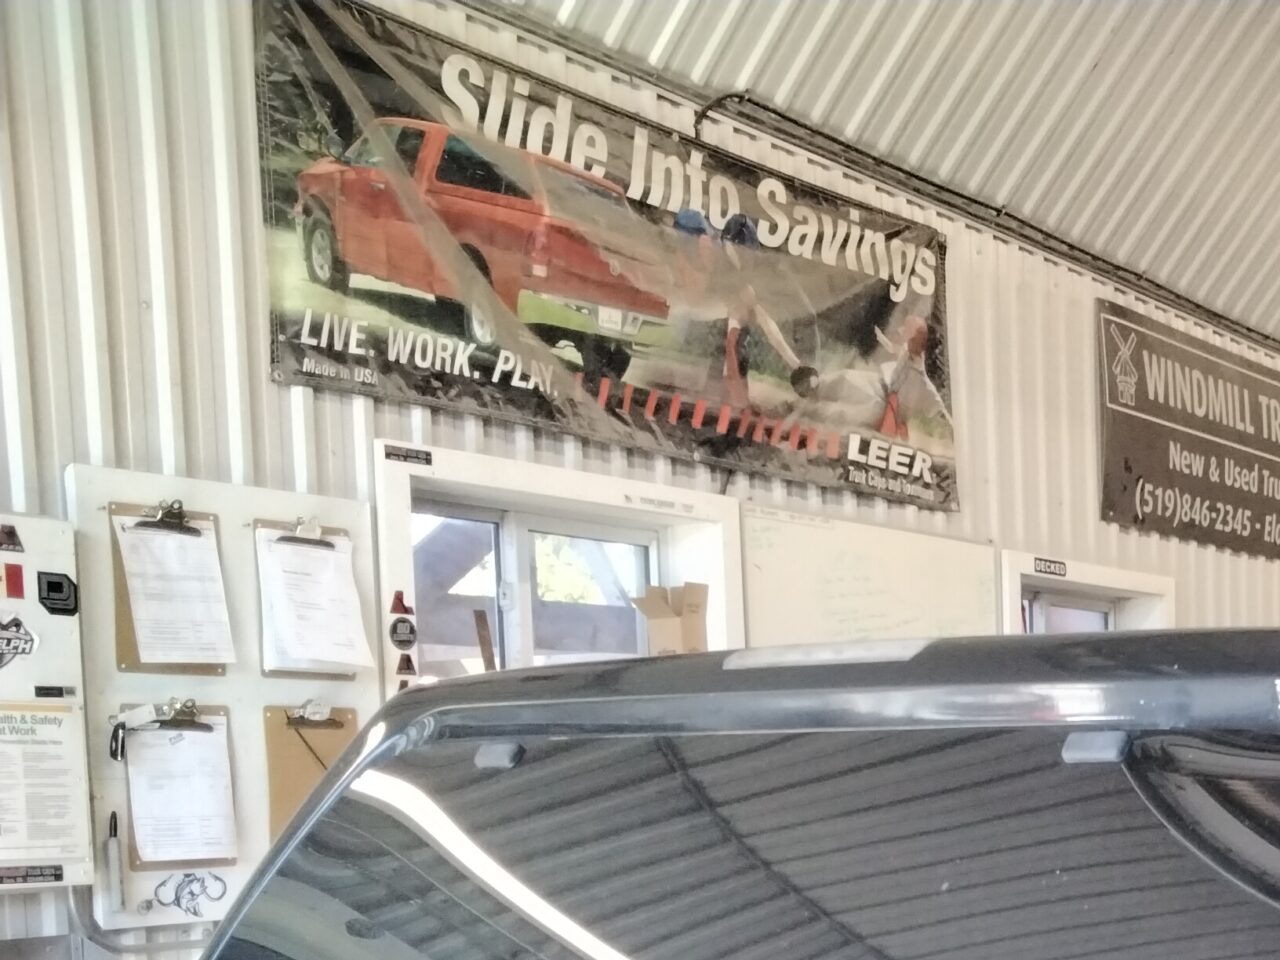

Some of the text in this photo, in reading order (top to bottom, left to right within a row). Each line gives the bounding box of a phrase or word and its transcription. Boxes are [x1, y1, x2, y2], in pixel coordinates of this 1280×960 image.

[441, 54, 936, 302] Slide Into Savings
[301, 308, 559, 396] LIVE. WORK. PLAY.
[303, 357, 379, 386] Made in USA
[1142, 349, 1254, 434] WINDMILL
[847, 433, 933, 484] LEER
[1169, 440, 1204, 478] New
[1209, 456, 1220, 483] &
[1224, 458, 1258, 494] Used
[1135, 478, 1252, 537] (519)846-2345
[1036, 560, 1065, 576] DECKED
[8, 726, 37, 736] Work
[19, 714, 28, 725] &
[30, 714, 64, 728] Safety
